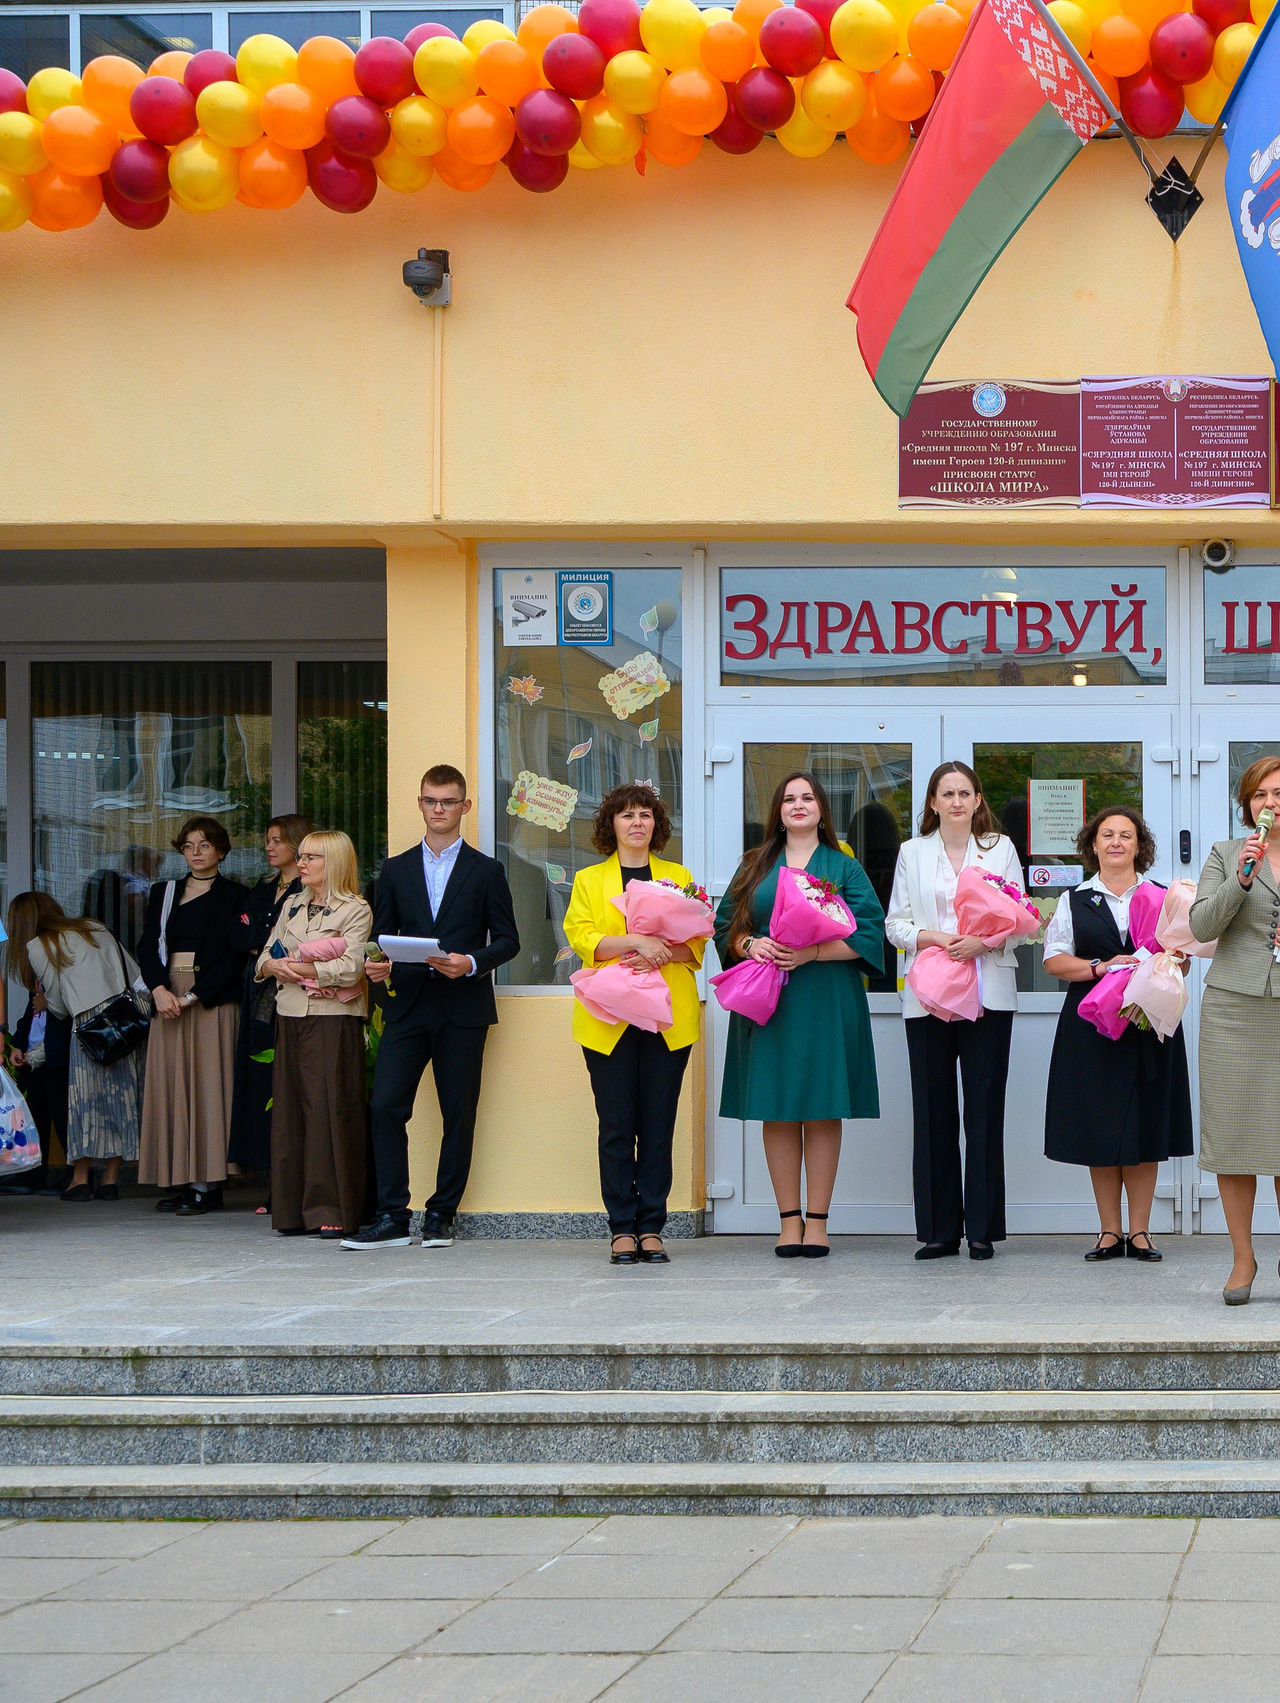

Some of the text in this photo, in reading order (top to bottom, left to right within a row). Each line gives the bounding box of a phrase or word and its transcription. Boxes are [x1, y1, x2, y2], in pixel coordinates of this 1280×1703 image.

[942, 420, 1038, 428] ГОСУДАРСТВЕННОМУ
[922, 430, 1056, 438] УЧРЕЖДЕНИЮ ОБРАЗОВАНИЯ
[902, 443, 950, 452] «Средняя
[990, 443, 1000, 452] №
[1005, 443, 1023, 452] 197
[1037, 443, 1077, 452] Минска
[1082, 451, 1136, 459] «СЯРЭДНЯЯ
[1178, 451, 1228, 459] «СРЕДНЯЯ
[949, 456, 985, 467] Героев
[989, 457, 1014, 465] 120-й
[1017, 458, 1066, 466] дивизии»
[943, 471, 1036, 479] ПРИСВОЕН СТАТУС
[1120, 470, 1150, 478] ГЕРОЯЎ
[930, 482, 1049, 492] «ШКОЛА МИРА»
[1099, 480, 1118, 488] 120-Й
[726, 584, 1162, 665] ЗДРАВСТВУЙ,
[617, 663, 638, 679] Буду
[610, 662, 655, 694] отличницей!
[555, 788, 573, 800] жду
[536, 791, 567, 807] осенние
